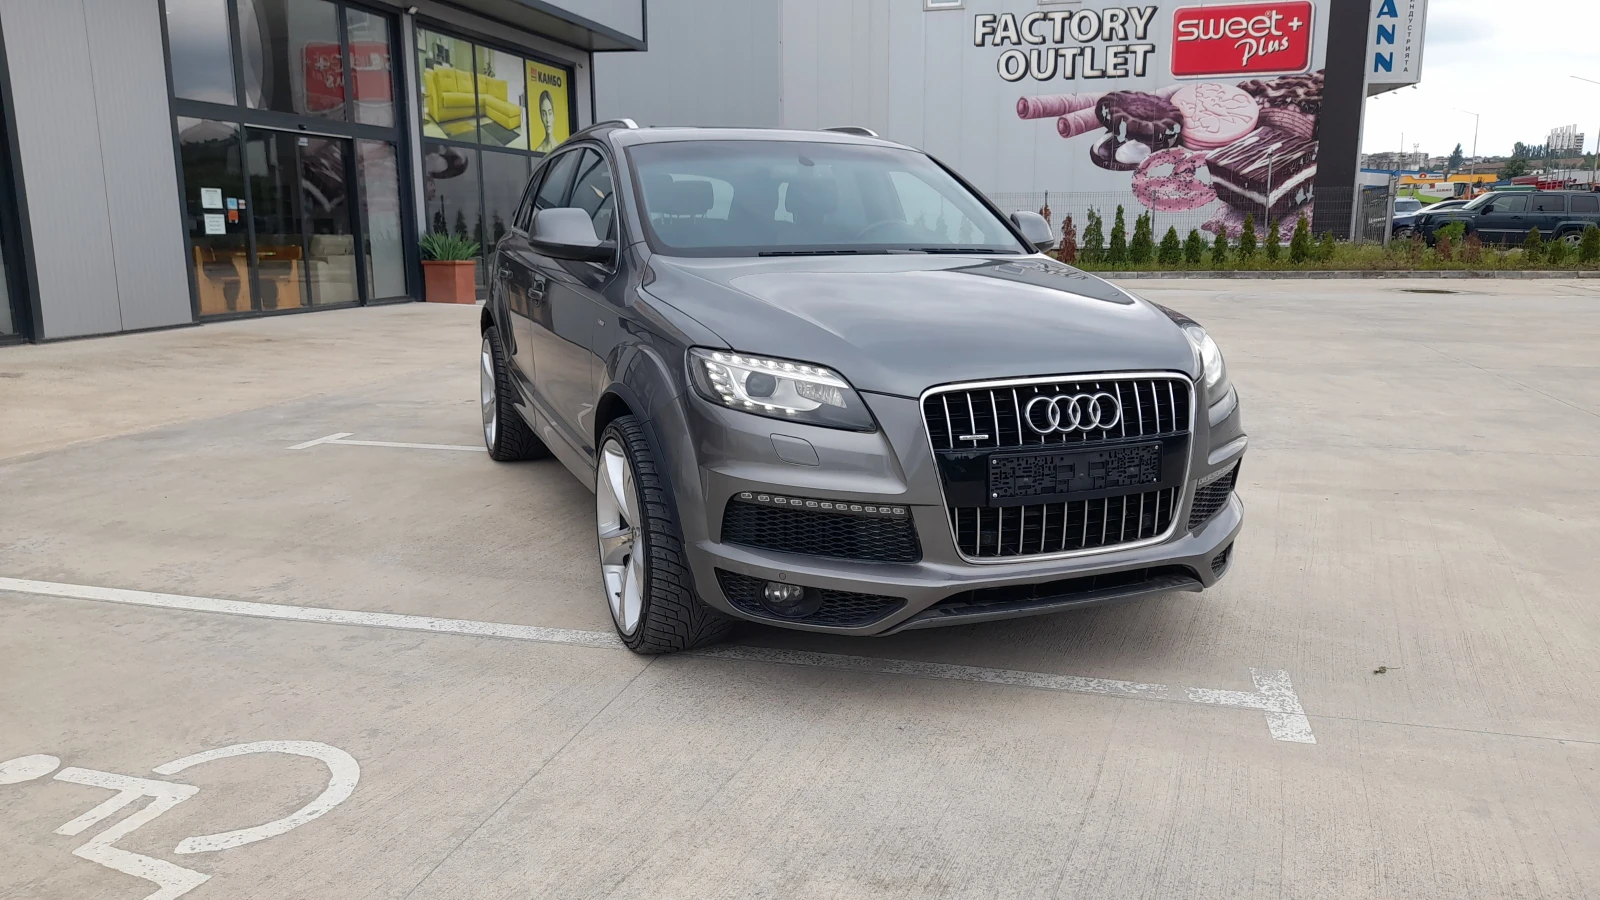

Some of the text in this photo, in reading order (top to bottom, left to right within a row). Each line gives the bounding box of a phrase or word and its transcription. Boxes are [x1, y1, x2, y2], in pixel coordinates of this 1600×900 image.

[974, 6, 1159, 47] FACTORY
[997, 44, 1156, 82] OUTLET
[1234, 36, 1289, 66] Plus
